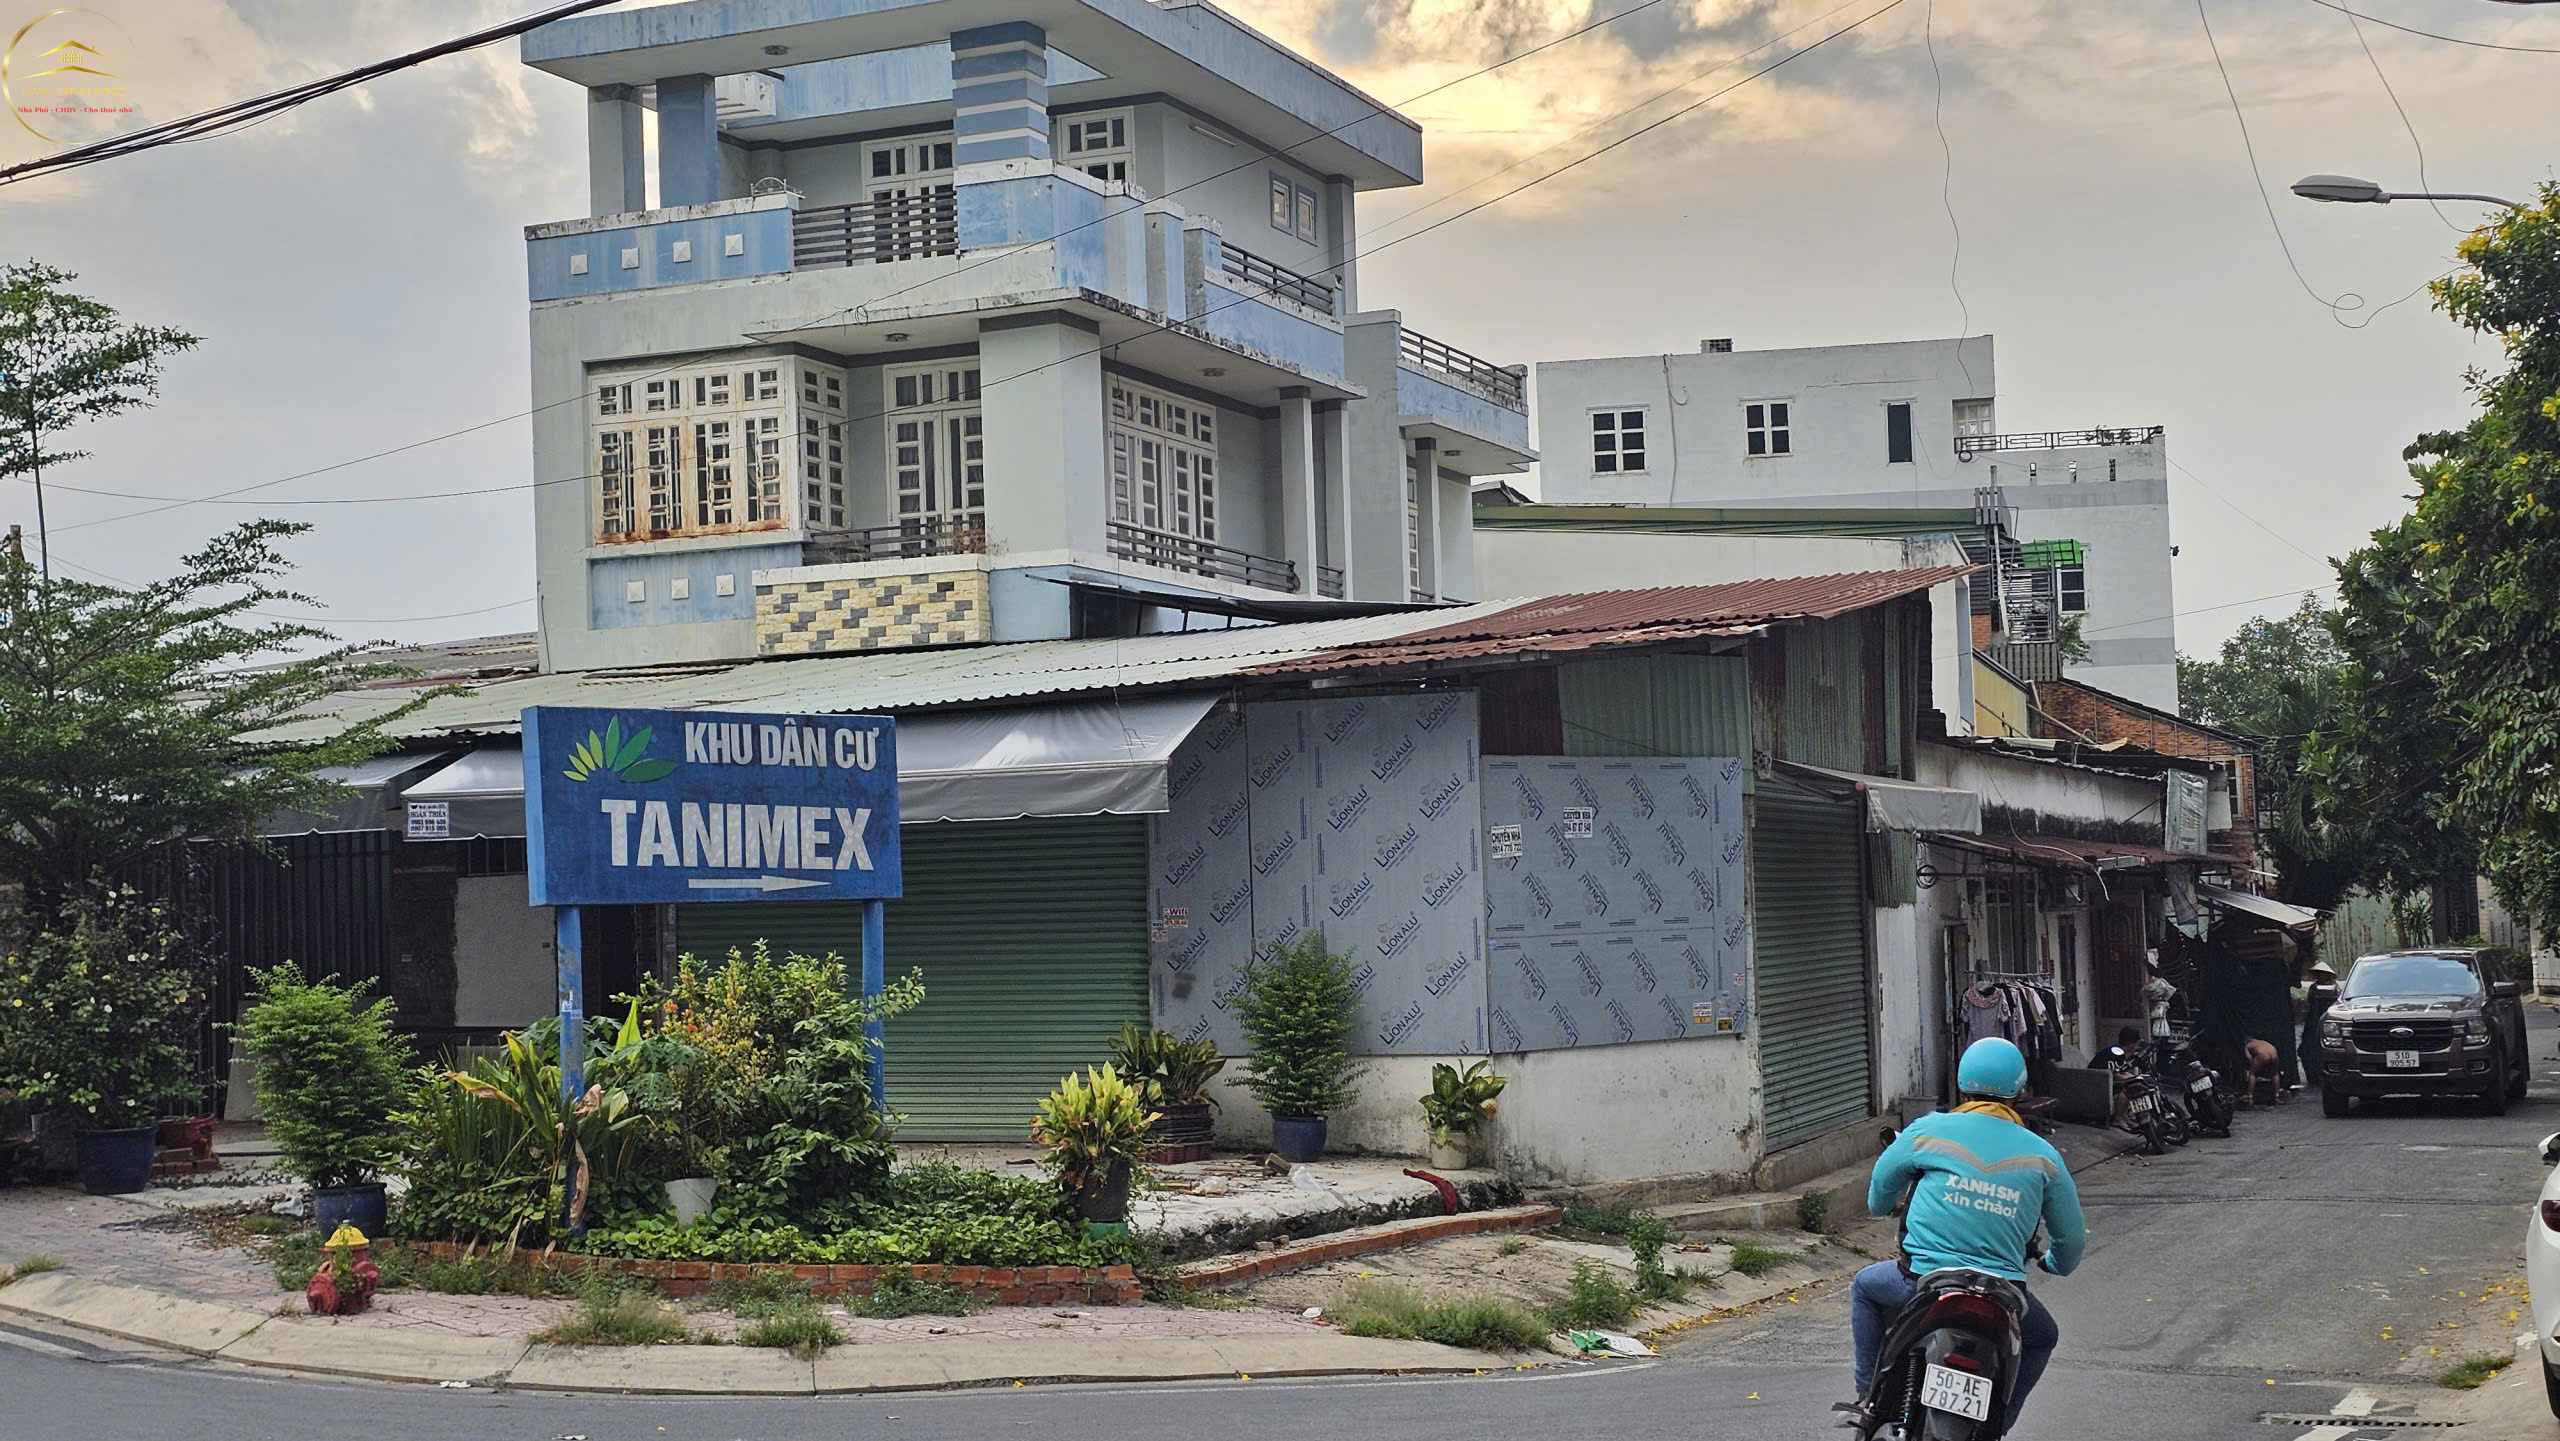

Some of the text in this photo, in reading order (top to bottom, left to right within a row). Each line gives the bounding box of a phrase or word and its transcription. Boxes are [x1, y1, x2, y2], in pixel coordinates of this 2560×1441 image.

[1324, 702, 1365, 742] LIONALU
[684, 718, 880, 771] KHU DÂN CƯ
[1371, 739, 1413, 780] LIONALU
[1251, 748, 1291, 788] LIONALU
[1208, 796, 1247, 837] LIONALU
[1327, 788, 1368, 830] LIONALU
[1419, 777, 1461, 819] LIONALU
[1515, 777, 1543, 821] LIONALU
[1627, 777, 1654, 820] LIONALU
[1681, 777, 1708, 819] LIONALU
[601, 798, 874, 871] TANIMEX
[1253, 835, 1294, 874] LIONALU
[1374, 827, 1416, 868] LIONALU
[1548, 826, 1575, 869] LIONALU
[1604, 825, 1631, 868] LIONALU
[1658, 824, 1685, 867] LIONALU
[1165, 846, 1204, 885] LIONALU
[1210, 883, 1250, 923] LIONALU
[1329, 877, 1371, 917] LIONALU
[1422, 866, 1464, 907] LIONALU
[1524, 876, 1551, 919] LIONALU
[1580, 874, 1608, 917] LIONALU
[1635, 873, 1662, 914] LIONALU
[1689, 871, 1714, 912] LIONALU
[1167, 931, 1206, 971] LIONALU
[1377, 916, 1418, 956] LIONALU
[1425, 955, 1467, 996] LIONALU
[1518, 958, 1546, 1000] LIONALU
[1575, 955, 1602, 997] LIONALU
[1630, 952, 1656, 993] LIONALU
[1683, 949, 1708, 990] LIONALU
[1379, 1004, 1421, 1045] LIONALU
[1492, 1009, 1521, 1051] LIONALU
[1551, 1005, 1578, 1047] LIONALU
[1607, 1001, 1632, 1043] LIONALU
[1661, 998, 1686, 1038] LIONALU
[1943, 1191, 2017, 1218] xin chào!
[1945, 1174, 1996, 1198] XANH
[1925, 1387, 1982, 1416] 787.21
[1936, 1371, 1981, 1397] 50-AE
